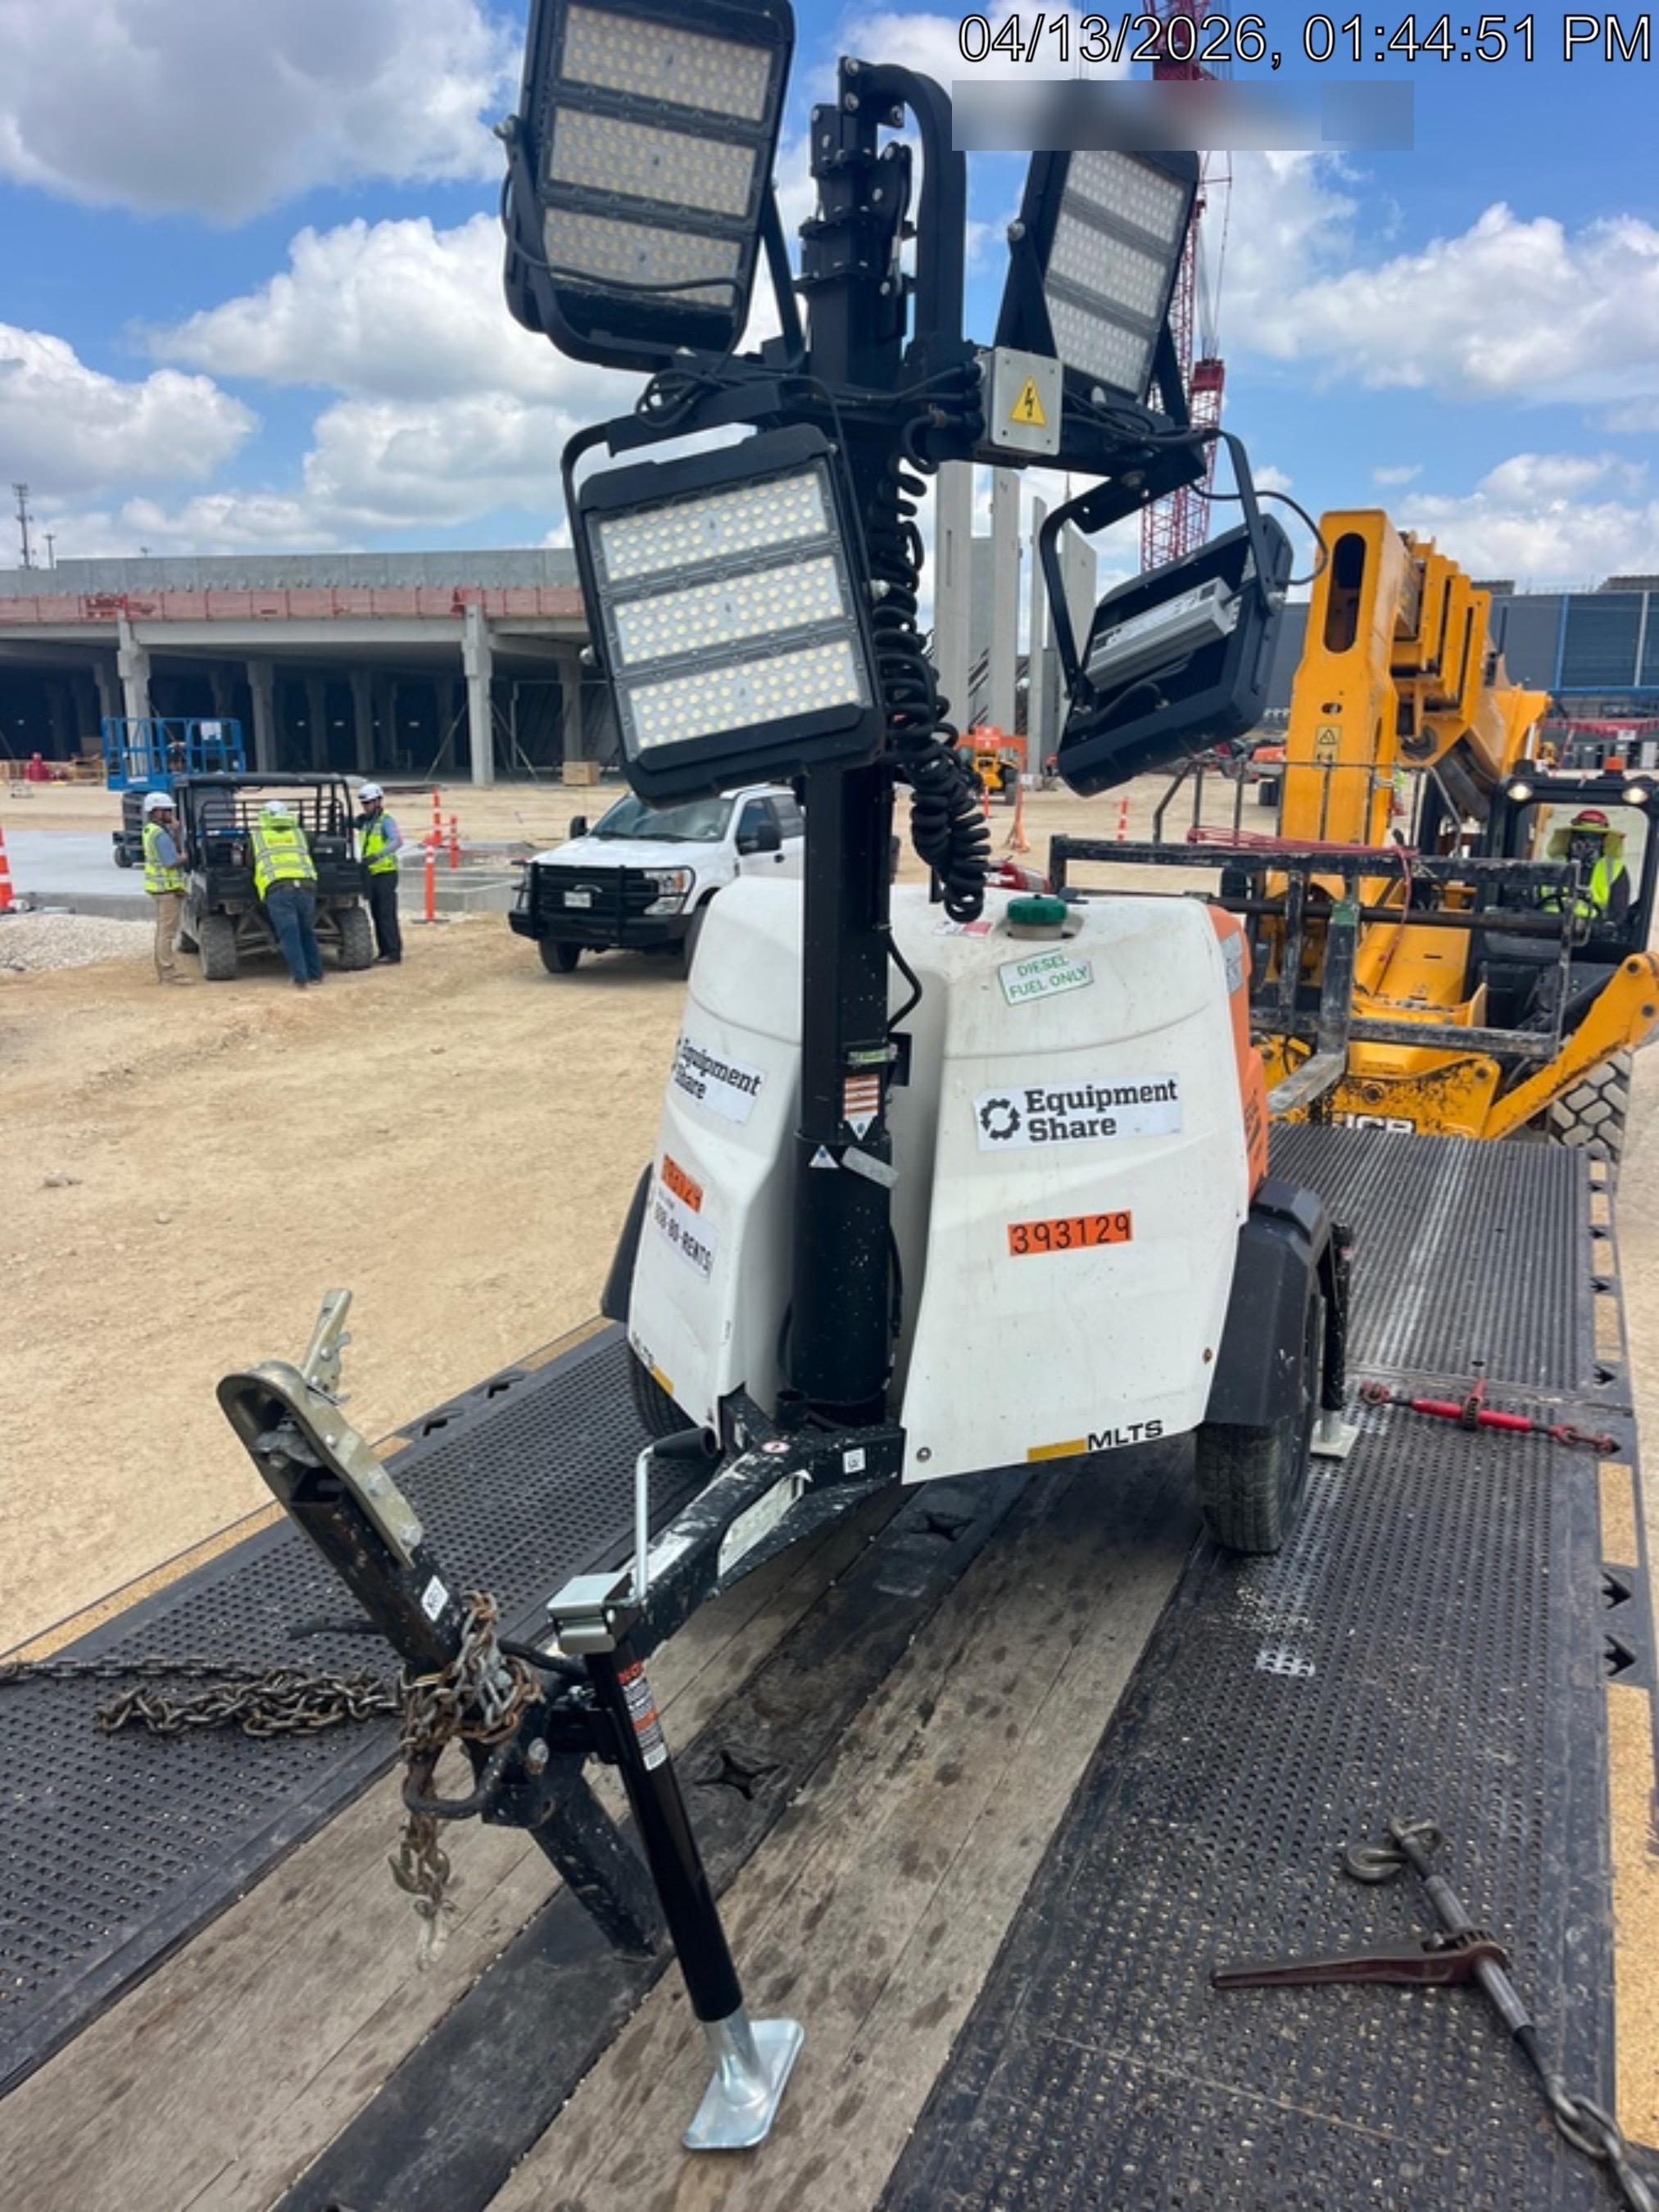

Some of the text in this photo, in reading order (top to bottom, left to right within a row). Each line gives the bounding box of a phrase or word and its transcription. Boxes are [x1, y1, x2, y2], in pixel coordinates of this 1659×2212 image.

[1009, 965, 1087, 999] FUEL ONLY
[1017, 954, 1069, 977] DIESEL
[1024, 1079, 1178, 1116] Equipment
[1027, 1116, 1117, 1143] Share
[1011, 1212, 1131, 1254] 393129
[1087, 1419, 1163, 1451] MLTS
